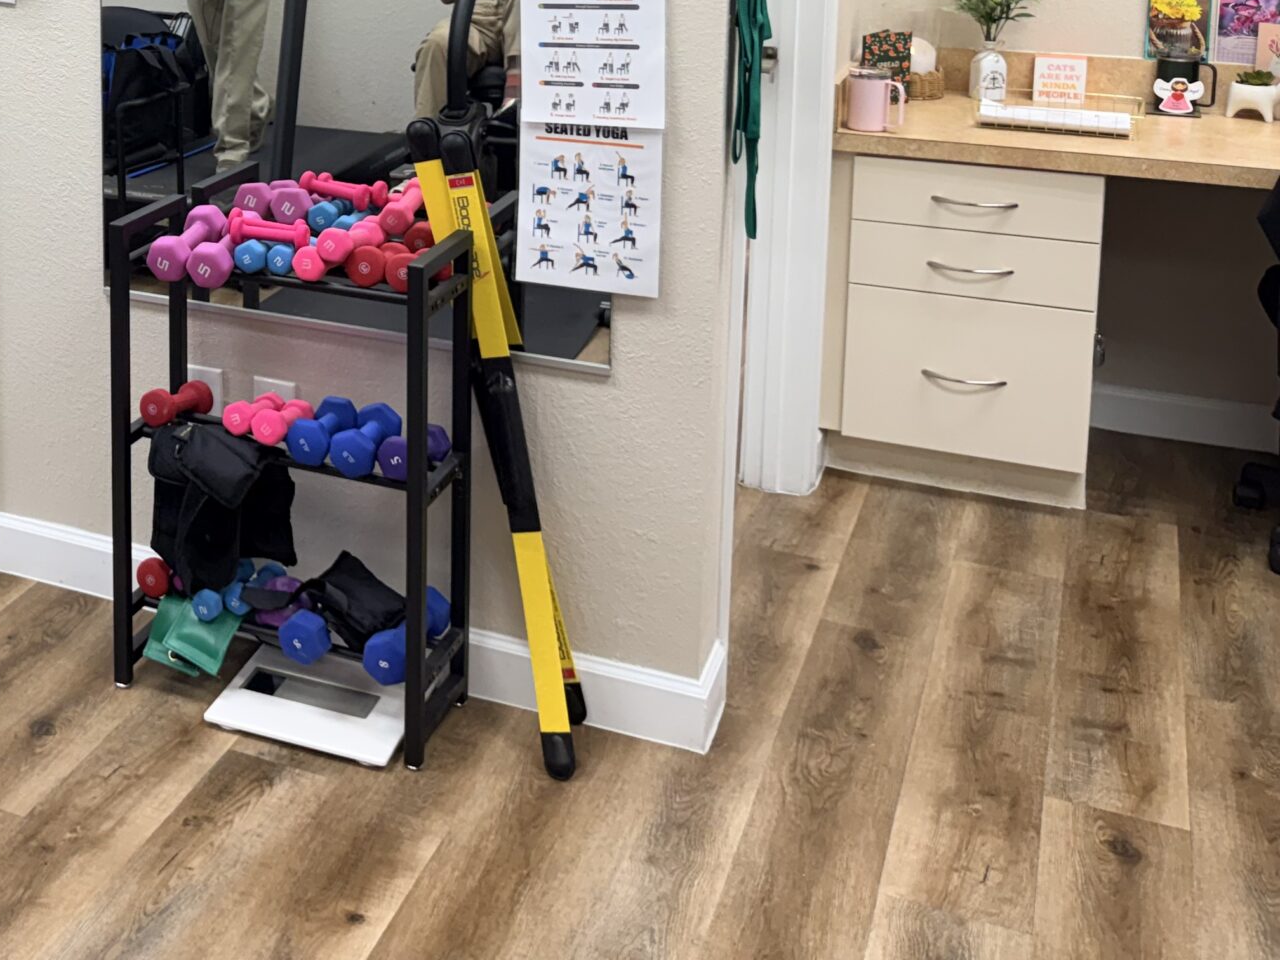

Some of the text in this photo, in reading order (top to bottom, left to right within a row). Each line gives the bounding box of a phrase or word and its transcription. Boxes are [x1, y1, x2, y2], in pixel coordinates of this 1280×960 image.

[1047, 63, 1076, 71] CATS
[1041, 82, 1077, 90] KINDA
[1038, 90, 1082, 100] PEOPLE
[544, 122, 629, 140] SEATED YOGA
[156, 256, 170, 272] 5
[273, 255, 285, 267] 2
[197, 263, 211, 279] 5
[390, 455, 402, 466] 5
